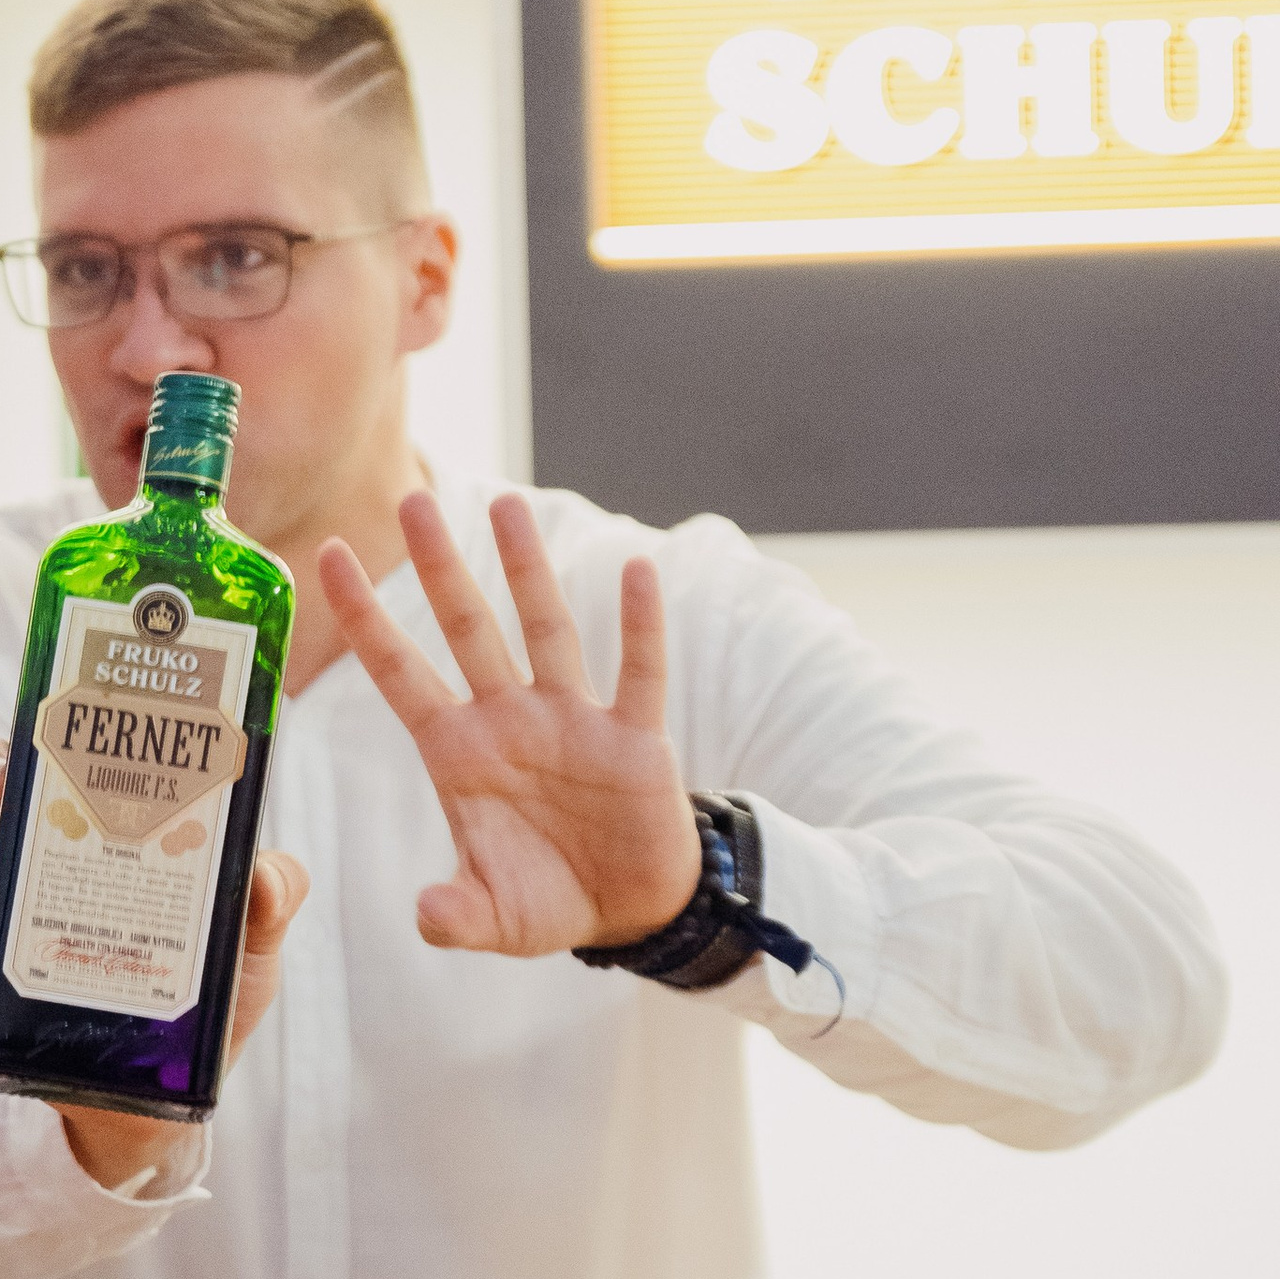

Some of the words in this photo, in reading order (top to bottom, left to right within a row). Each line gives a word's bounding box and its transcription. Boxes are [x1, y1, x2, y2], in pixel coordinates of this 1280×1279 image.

[107, 639, 199, 673] FRUKO
[93, 660, 203, 699] SCHULZ
[60, 700, 221, 774] FERNET
[86, 764, 151, 799] LIQUORE
